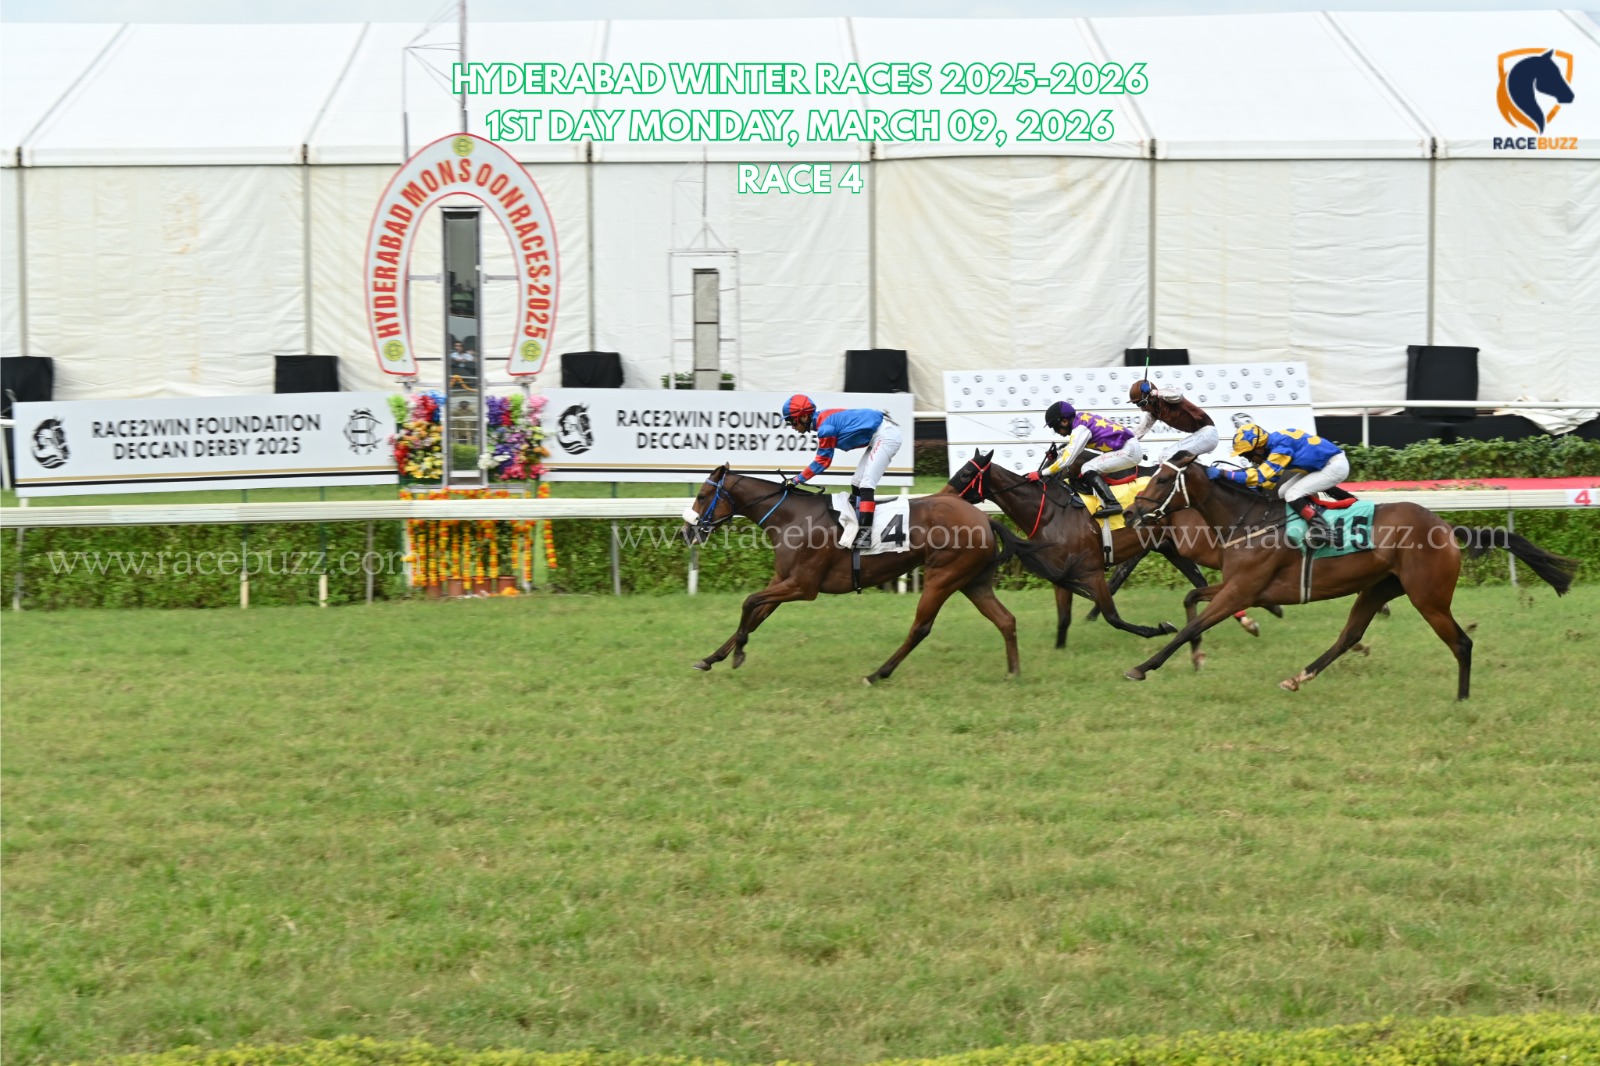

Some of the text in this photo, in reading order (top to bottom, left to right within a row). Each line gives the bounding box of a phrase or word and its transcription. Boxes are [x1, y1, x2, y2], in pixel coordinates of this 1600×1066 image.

[373, 203, 414, 338] HYDERABAD
[400, 158, 525, 209] MONSOON
[92, 414, 321, 438] RACE2WIN FOUNDATION
[616, 409, 712, 427] RACE2WIN
[113, 436, 301, 459] DECCAN DERBY 2025
[636, 432, 818, 451] DECCAN DERBY 2025
[1574, 490, 1592, 506] 4
[880, 514, 906, 547] 4
